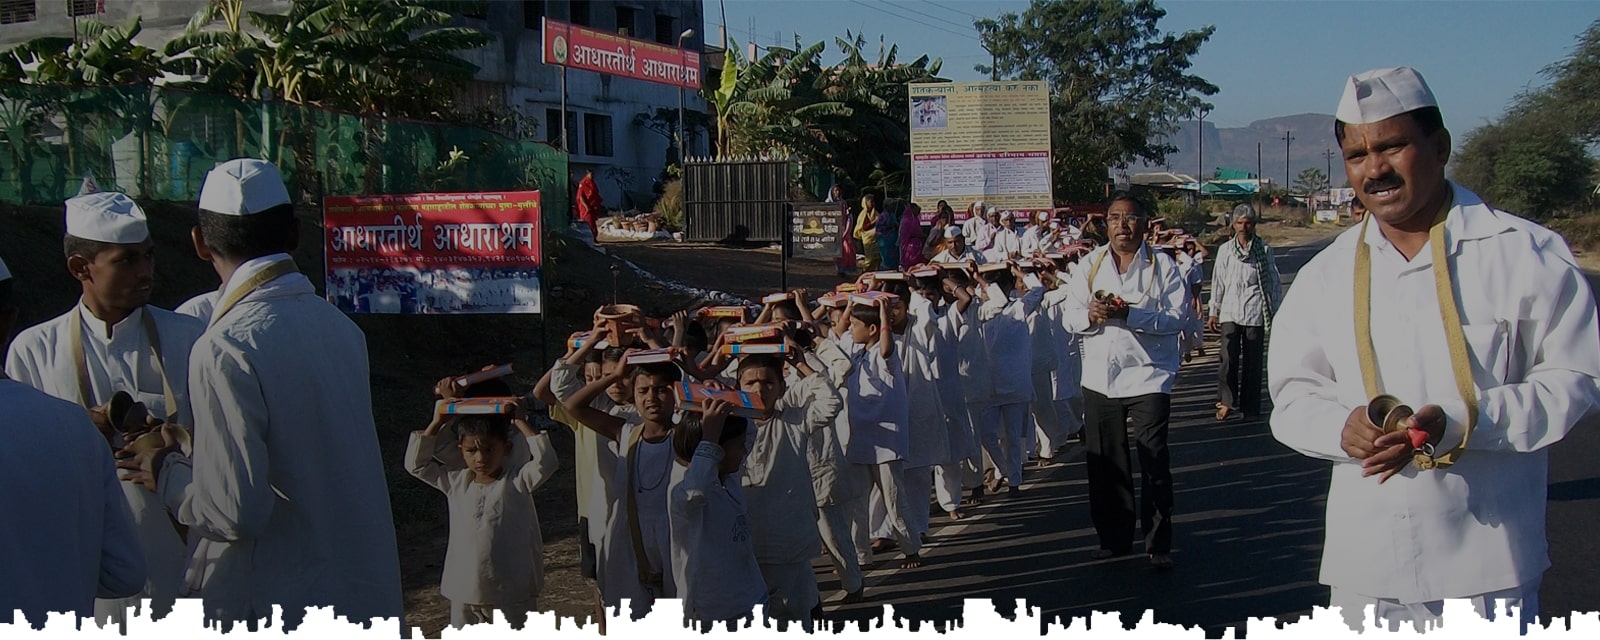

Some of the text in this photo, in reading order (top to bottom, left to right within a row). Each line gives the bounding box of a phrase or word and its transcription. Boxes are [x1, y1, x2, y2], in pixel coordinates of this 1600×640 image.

[572, 43, 699, 84] आधारतीर्थ आधाराश्रम
[331, 212, 534, 253] आधारतीर्थ आधाराश्रम
